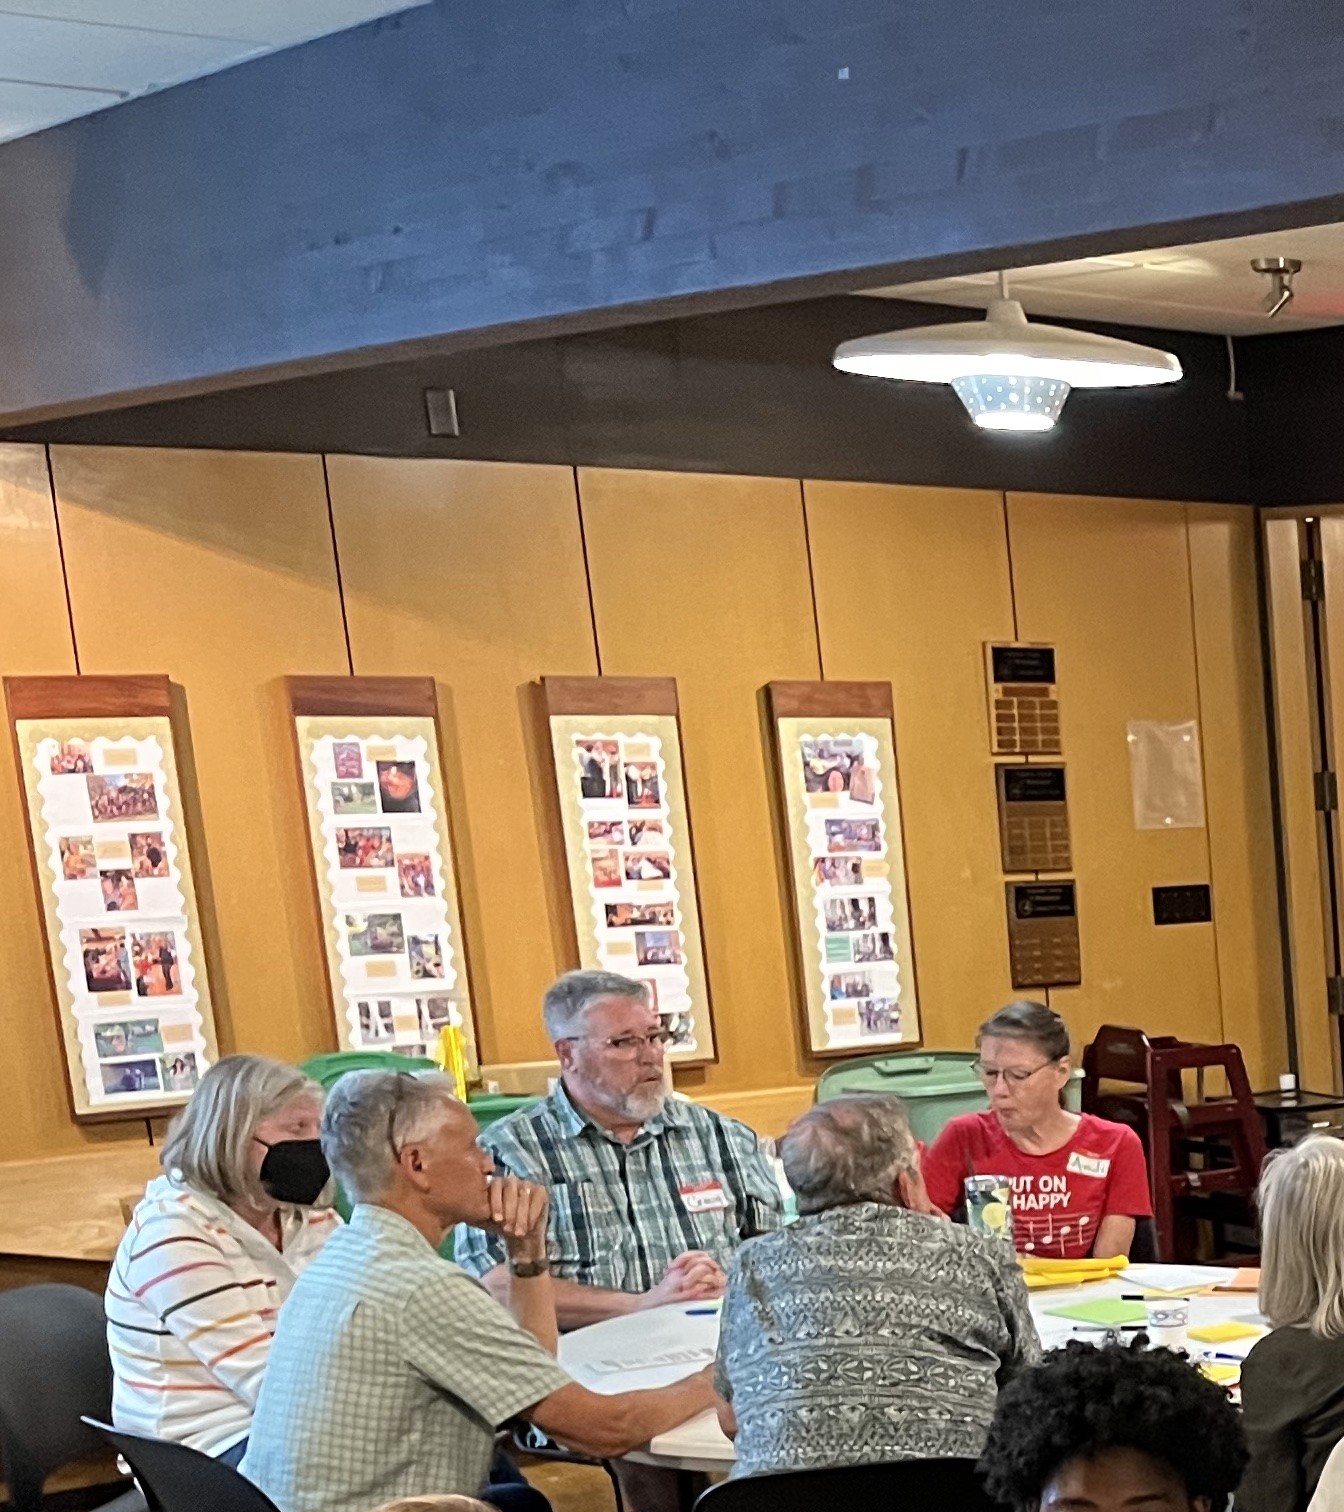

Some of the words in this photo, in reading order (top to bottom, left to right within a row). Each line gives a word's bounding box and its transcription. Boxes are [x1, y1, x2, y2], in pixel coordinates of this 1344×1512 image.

[1009, 1175, 1034, 1193] UT
[1038, 1175, 1067, 1193] ON
[1012, 1191, 1072, 1211] HAPPY
